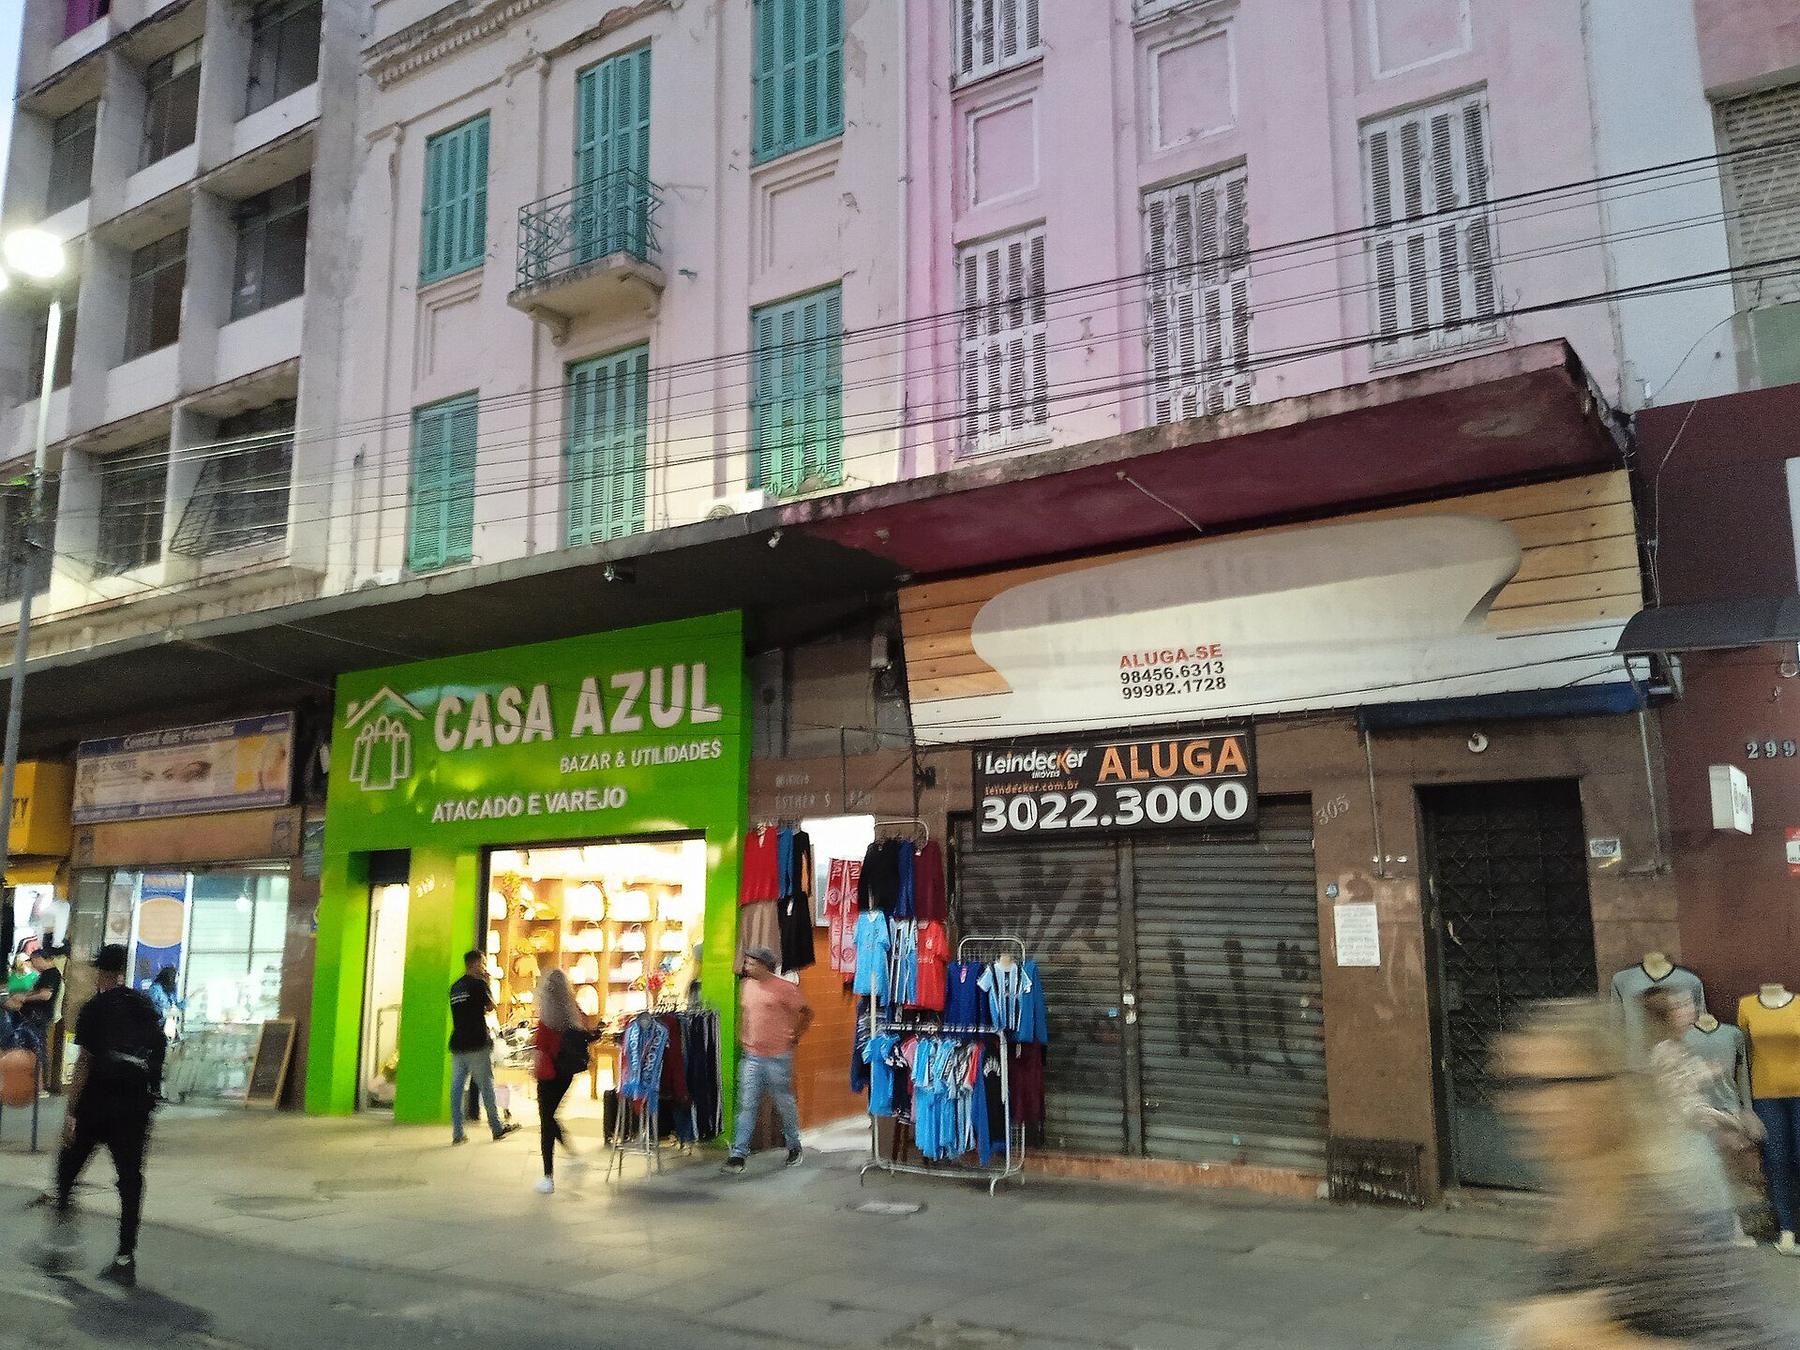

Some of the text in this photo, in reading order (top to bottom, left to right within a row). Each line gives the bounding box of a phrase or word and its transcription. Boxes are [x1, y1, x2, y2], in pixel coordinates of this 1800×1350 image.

[1120, 643, 1223, 668] ALUGA-SE
[1120, 661, 1225, 685] 98456.6313
[1122, 676, 1227, 700] 99982.1728
[434, 663, 722, 752] CASA AZUL
[559, 739, 722, 775] BAZAR & UTILIDADES
[1097, 738, 1248, 782] ALUGA
[1746, 741, 1797, 760] 299
[431, 784, 628, 824] ATACADO E VAREJO
[981, 781, 1249, 833] 3022.3000
